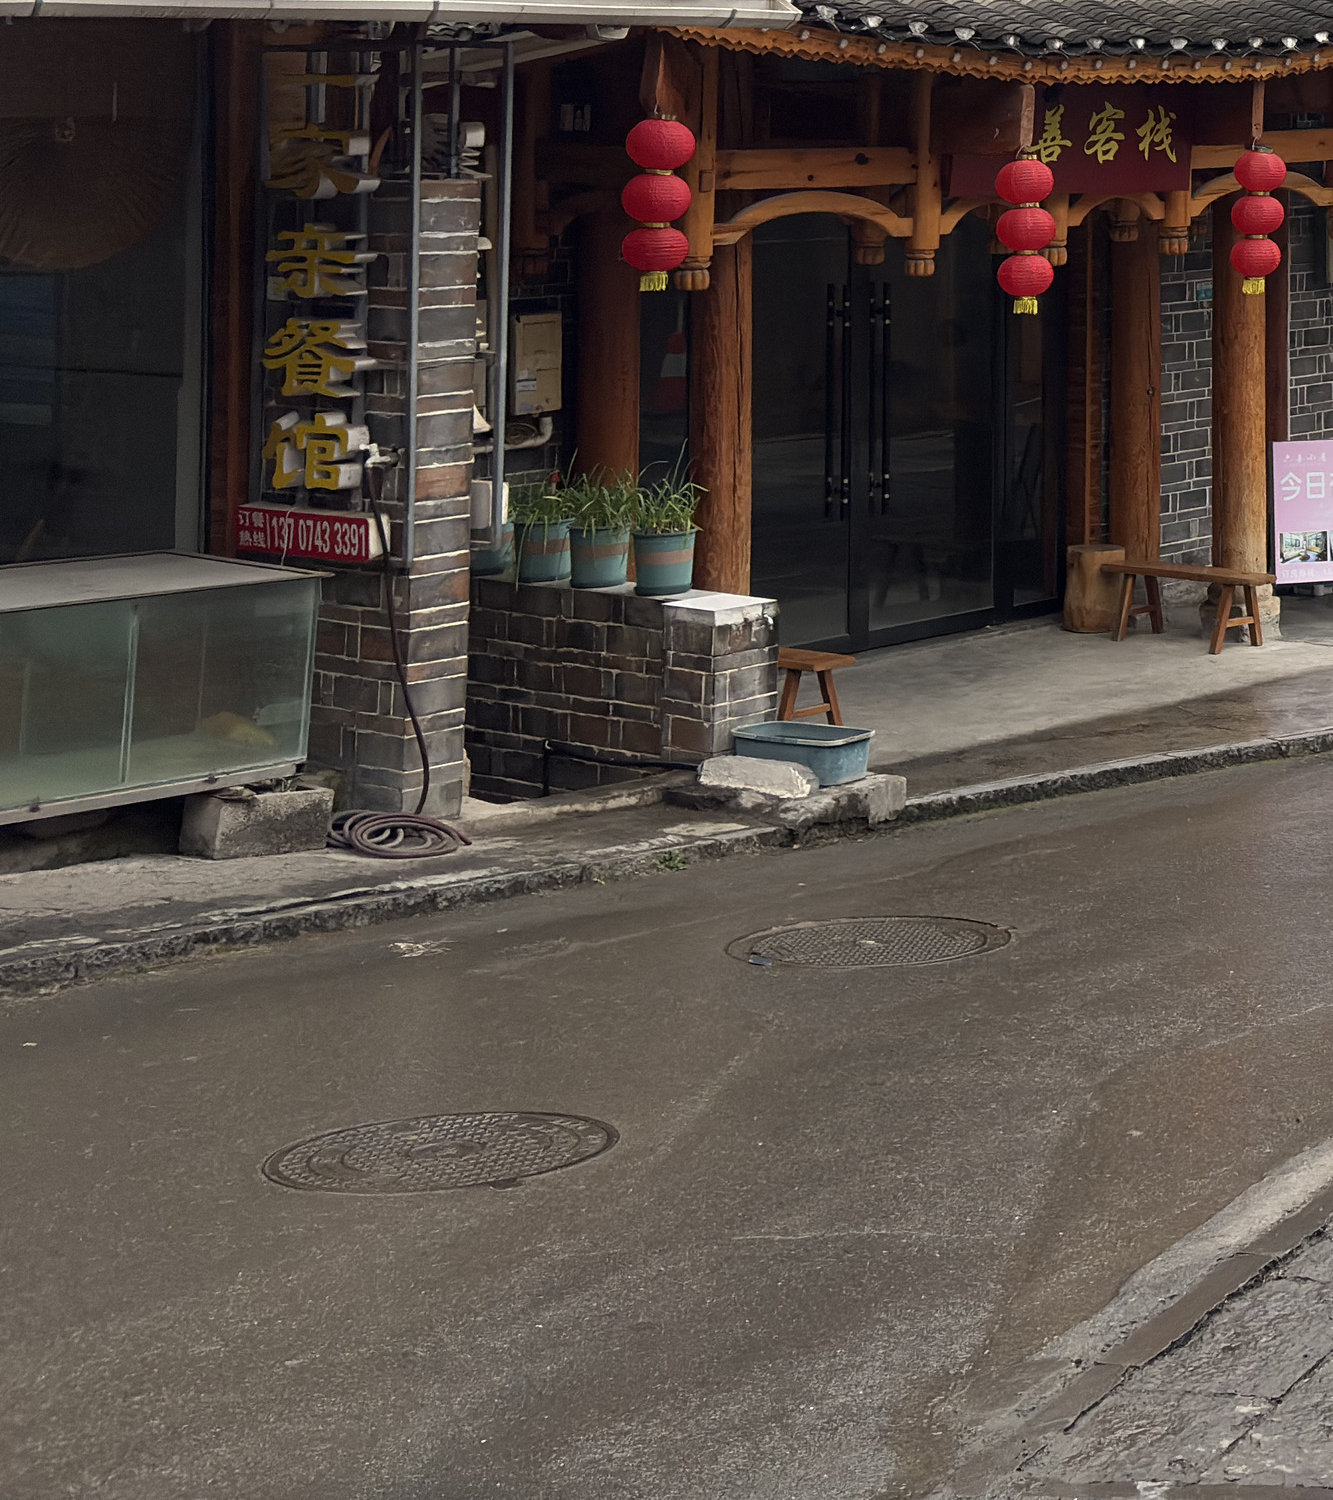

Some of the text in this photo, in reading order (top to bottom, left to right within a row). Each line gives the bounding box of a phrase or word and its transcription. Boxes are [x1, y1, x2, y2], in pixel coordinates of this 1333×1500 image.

[239, 530, 267, 549] 热线
[271, 515, 366, 558] 137 0743 3391
